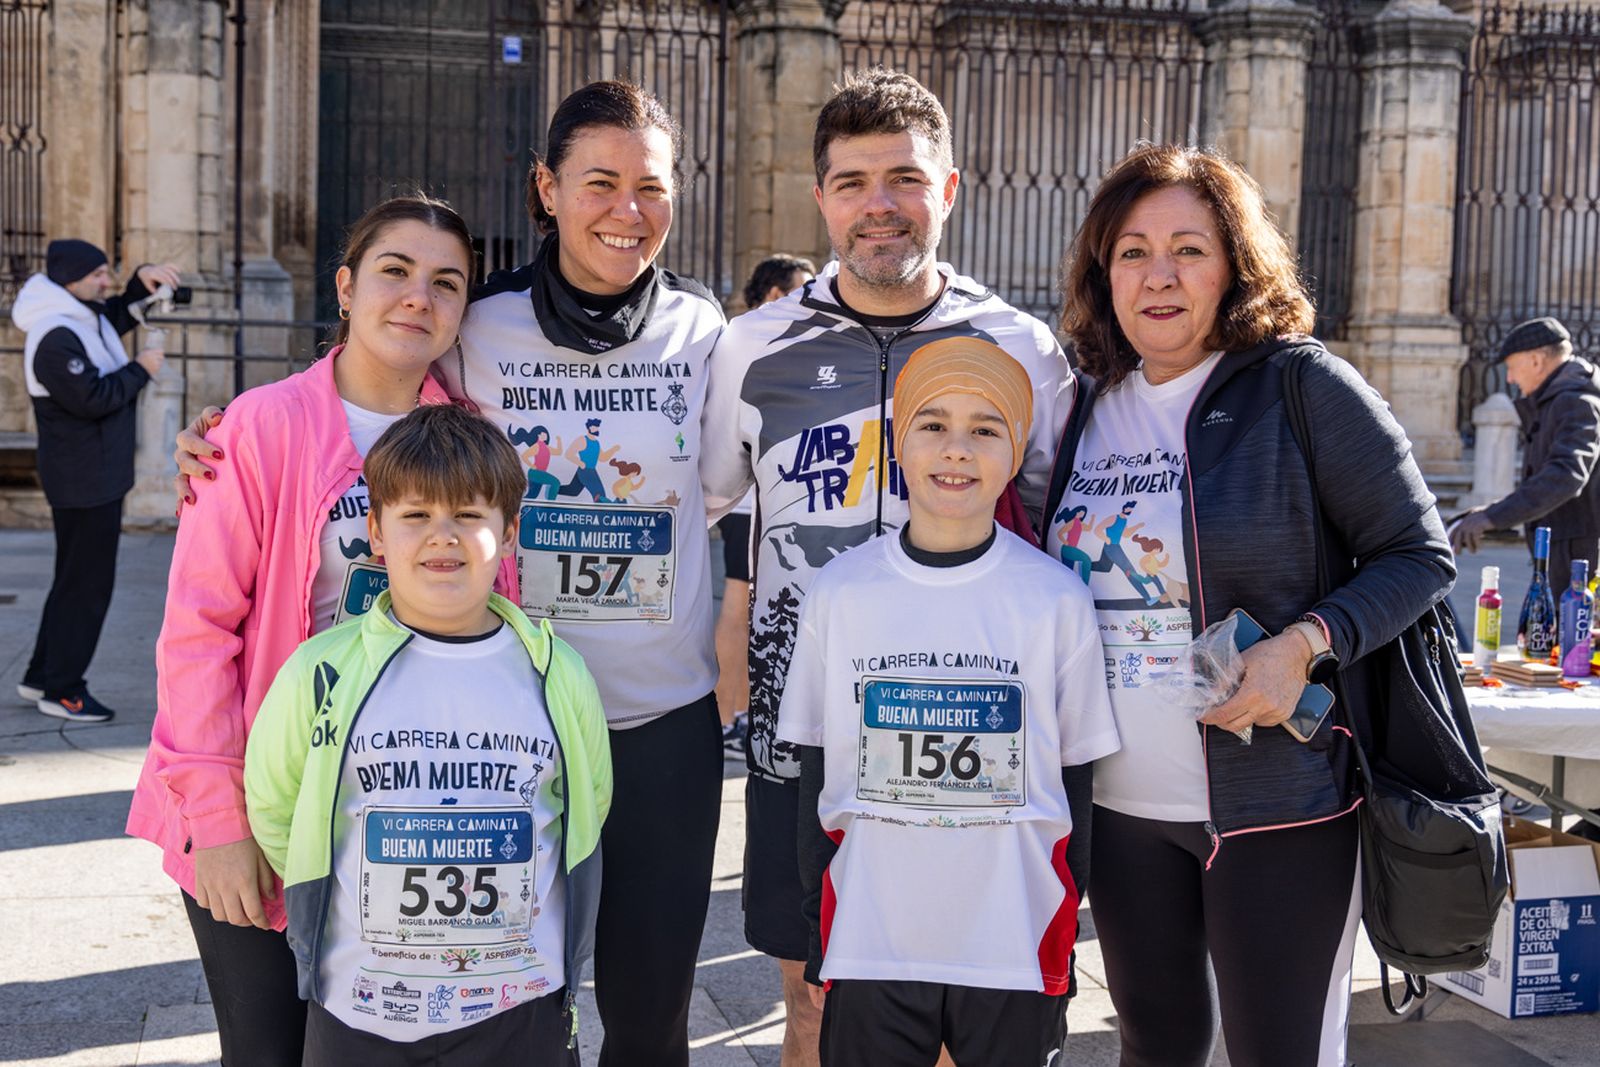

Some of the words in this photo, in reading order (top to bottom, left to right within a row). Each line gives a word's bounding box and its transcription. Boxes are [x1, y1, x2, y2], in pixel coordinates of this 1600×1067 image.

[498, 362, 515, 377] VI
[520, 362, 602, 378] CARRERA
[607, 362, 692, 378] CAMINATA
[502, 387, 567, 411] BUENA
[574, 387, 658, 412] MUERTE
[1095, 452, 1152, 471] CARRERA
[536, 512, 547, 523] VI
[549, 512, 600, 526] CARRERA
[602, 514, 657, 527] CAMINATA
[534, 528, 577, 547] BUENA
[580, 530, 632, 549] MUERTE
[557, 554, 634, 597] 157
[852, 658, 865, 672] VI
[868, 652, 939, 671] CARRERA
[943, 652, 1019, 675] CAMINATA
[880, 687, 891, 698] VI
[892, 687, 943, 701] CARRERA
[946, 690, 1003, 703] CAMINATA
[877, 705, 918, 725] BUENA
[923, 708, 979, 727] MUERTE
[370, 729, 461, 750] CARRERA
[898, 732, 982, 781] 156
[356, 760, 421, 793] BUENA
[429, 761, 517, 792] MUERTE
[382, 819, 394, 831] VI
[396, 818, 454, 832] CARRERA
[457, 817, 519, 831] CAMINATA
[381, 838, 427, 858] BUENA
[432, 838, 493, 858] MUERTE
[399, 866, 499, 917] 535
[398, 918, 426, 926] MIGUEL
[428, 918, 473, 926] BARRANCO
[1519, 918, 1535, 931] DE
[1519, 929, 1560, 942] VIRGEN
[378, 950, 417, 960] beneficio
[1518, 941, 1555, 954] EXTRA
[427, 1000, 450, 1010] CUA
[427, 1009, 442, 1018] LIA
